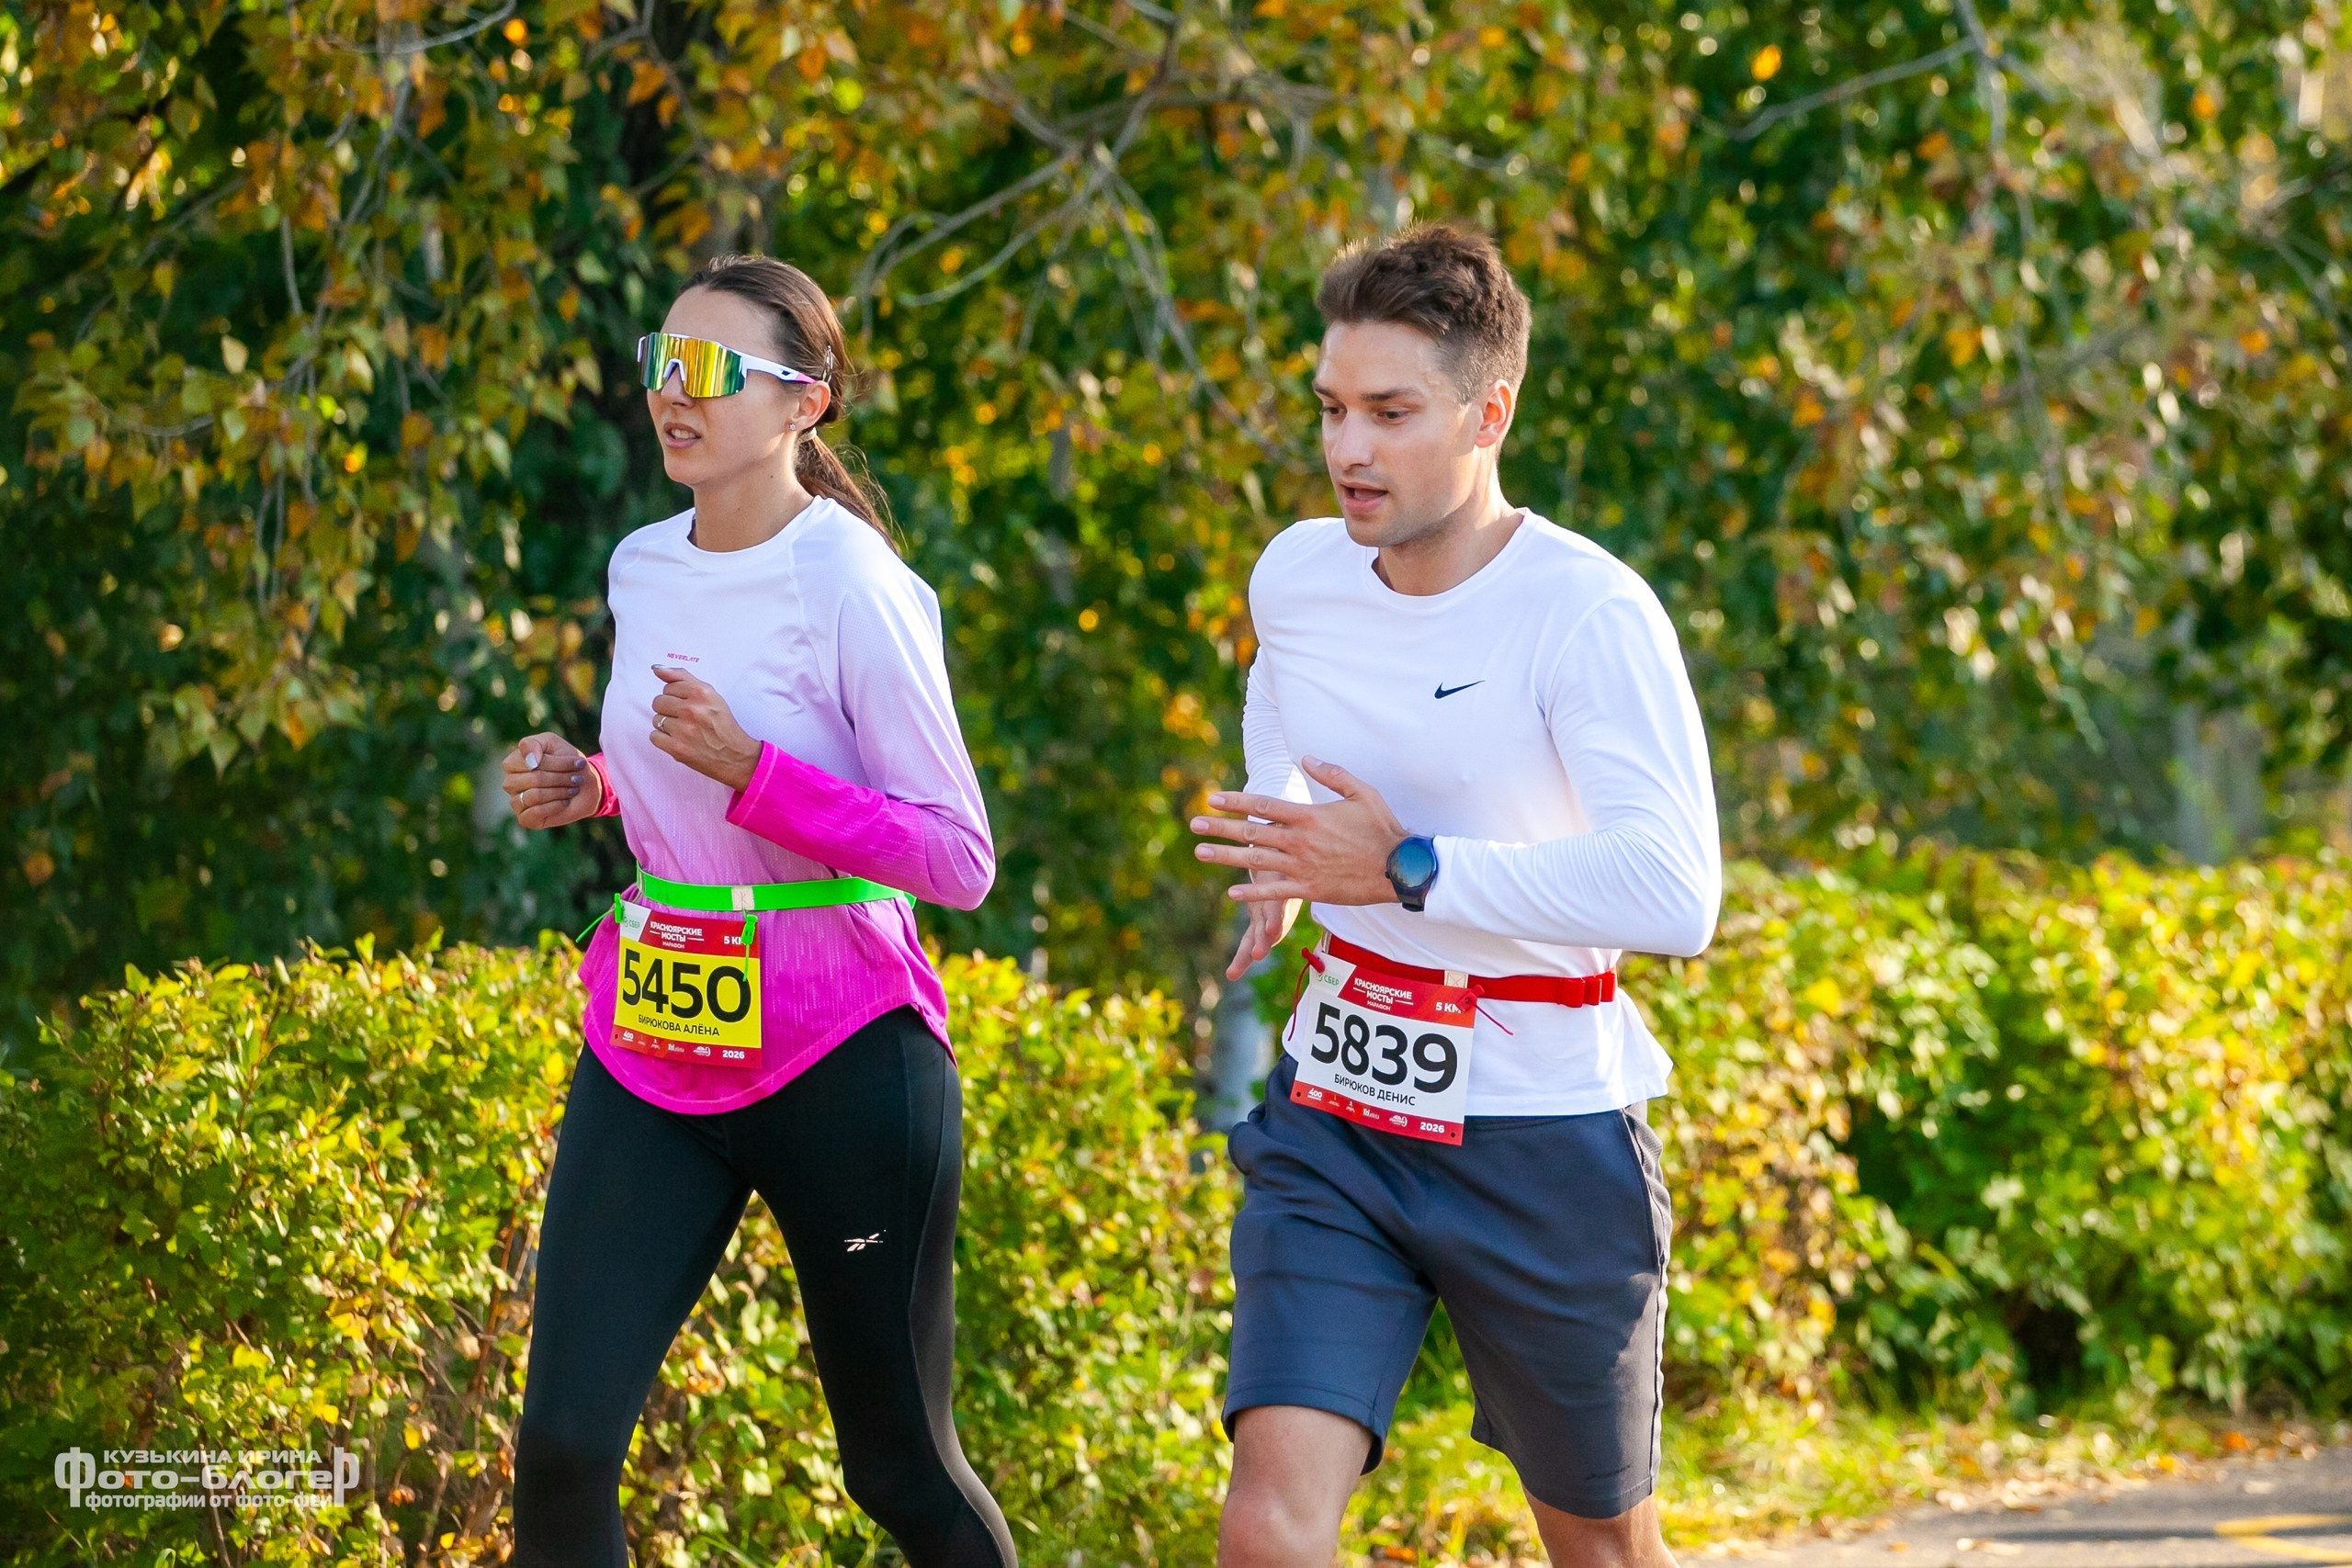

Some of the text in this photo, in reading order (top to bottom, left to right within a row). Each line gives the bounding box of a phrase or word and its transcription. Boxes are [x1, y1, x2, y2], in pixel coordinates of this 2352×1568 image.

[650, 920, 703, 936] КРАСНОЯРСКИЕ
[661, 931, 686, 942] МОСТЫ
[724, 935, 741, 945] 5 К
[622, 948, 752, 1023] 5450
[1324, 975, 1340, 986] СБЕР
[1354, 977, 1412, 999] КРАСНОЯРСКИЕ
[1366, 992, 1394, 1004] МОСТЫ
[1367, 1000, 1391, 1011] МАРАФОН
[1435, 1001, 1442, 1011] 5
[638, 1014, 719, 1036] БИРЮКОВА АЛЁНА
[1310, 1001, 1458, 1093] 5839
[722, 1050, 745, 1059] 2026
[1334, 1073, 1416, 1106] БИРЮКОВ ДЕНИС
[1419, 1122, 1445, 1134] 2026
